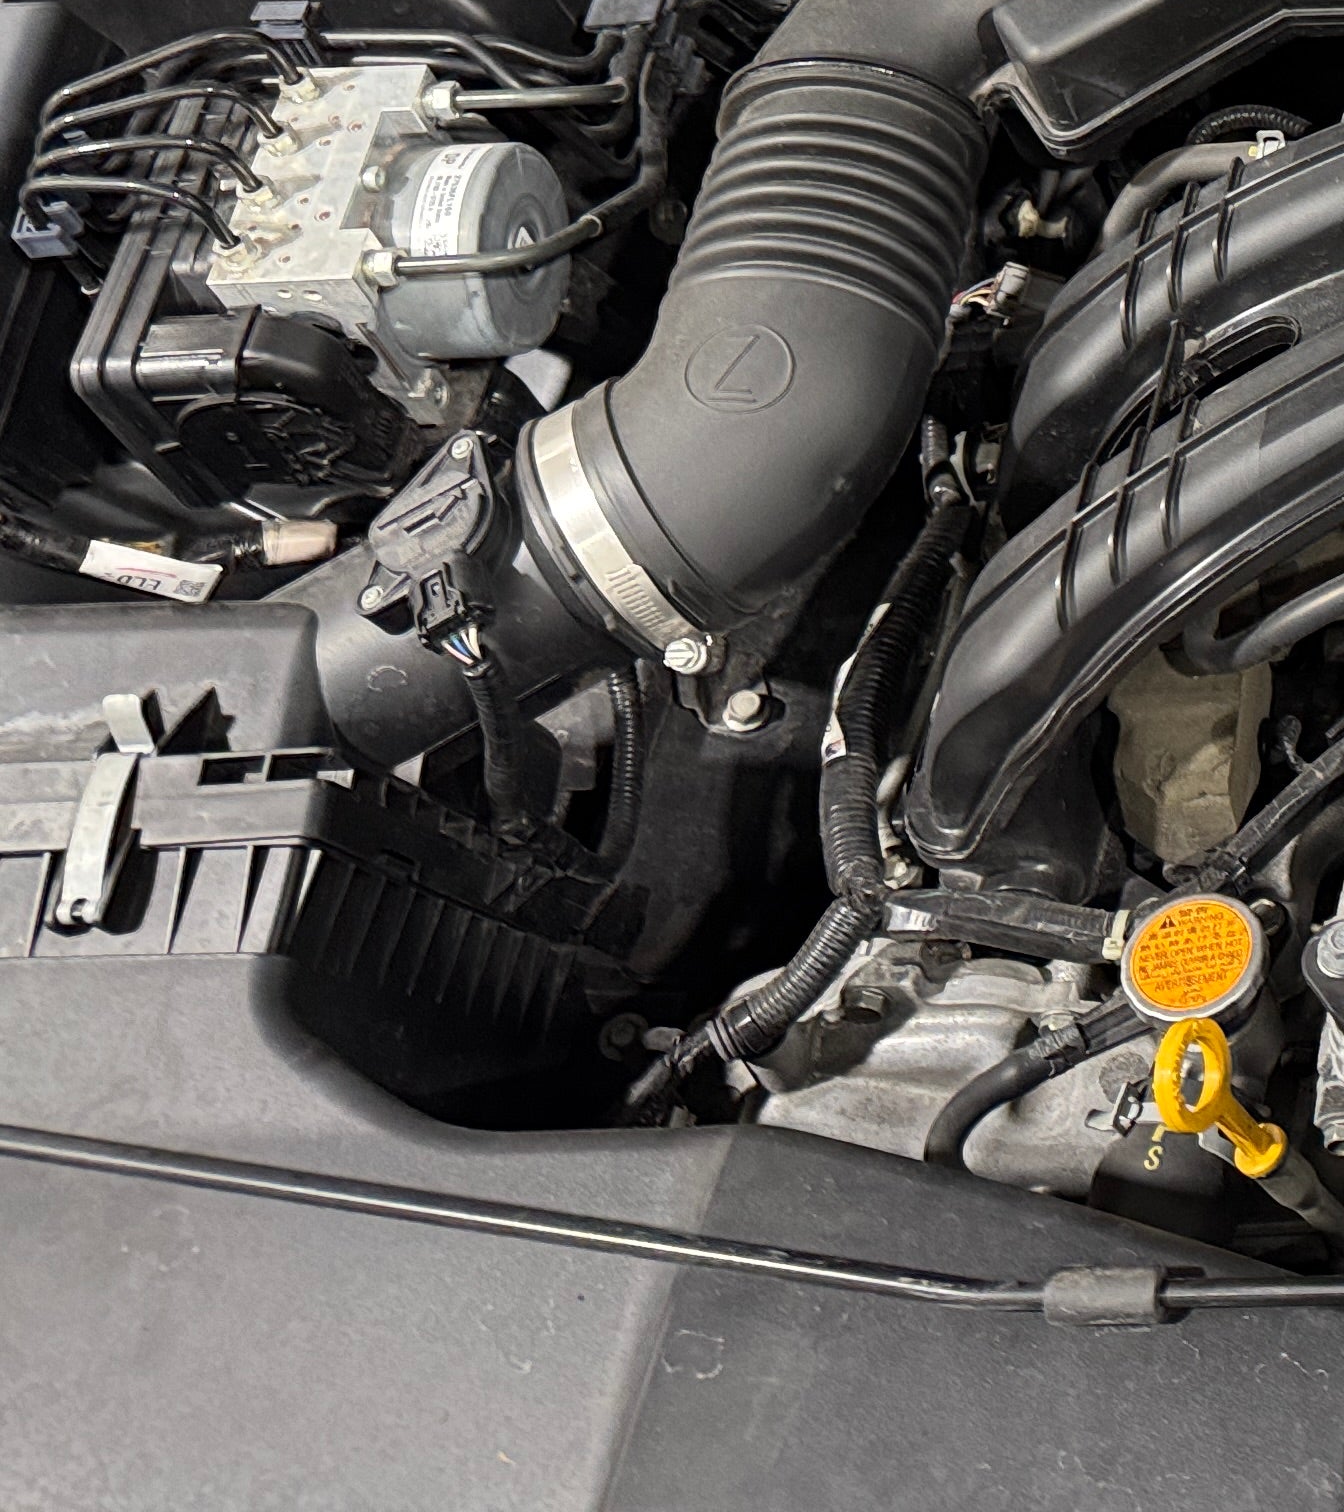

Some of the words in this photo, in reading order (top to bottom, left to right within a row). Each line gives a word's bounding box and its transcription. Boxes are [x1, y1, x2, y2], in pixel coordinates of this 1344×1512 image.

[1177, 911, 1224, 928] WARNING
[1139, 950, 1168, 964] NEVER
[1170, 946, 1194, 958] OPEN
[1196, 941, 1221, 954] WHEN
[1224, 937, 1243, 948] HOT
[1144, 1145, 1164, 1171] S
